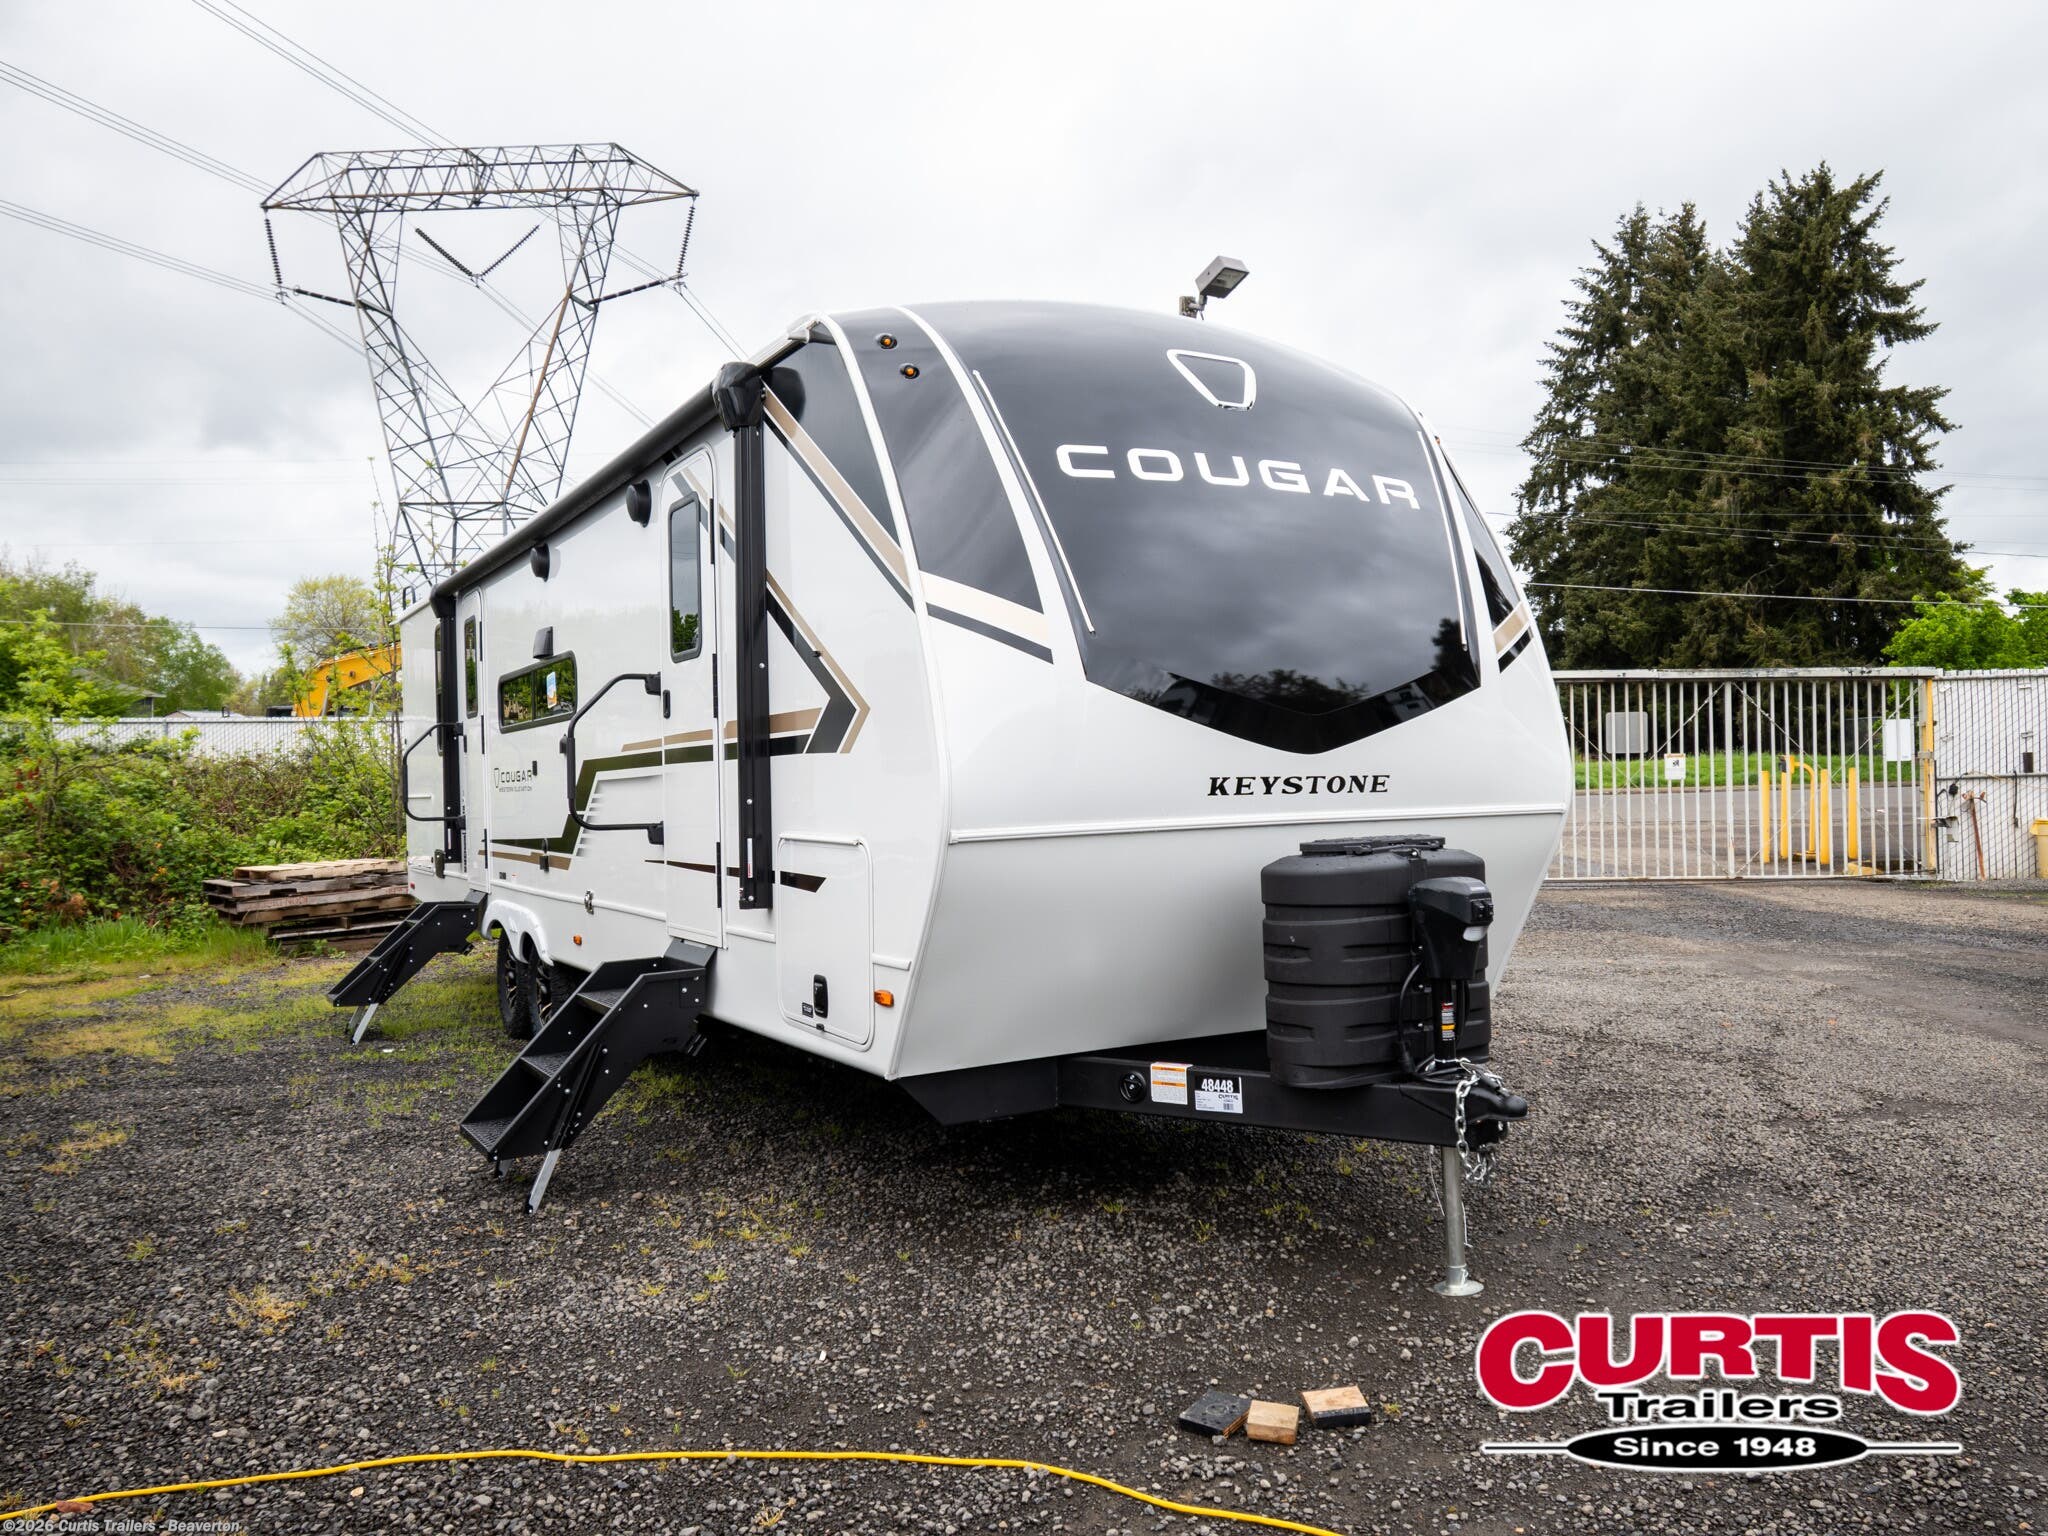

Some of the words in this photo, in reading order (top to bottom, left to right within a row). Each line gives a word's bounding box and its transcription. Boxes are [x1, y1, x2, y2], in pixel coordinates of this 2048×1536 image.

[1056, 444, 1419, 510] COUGAR
[501, 769, 532, 783] COUGAR
[1208, 774, 1391, 796] KEYSTONE
[1201, 1078, 1233, 1093] 48448
